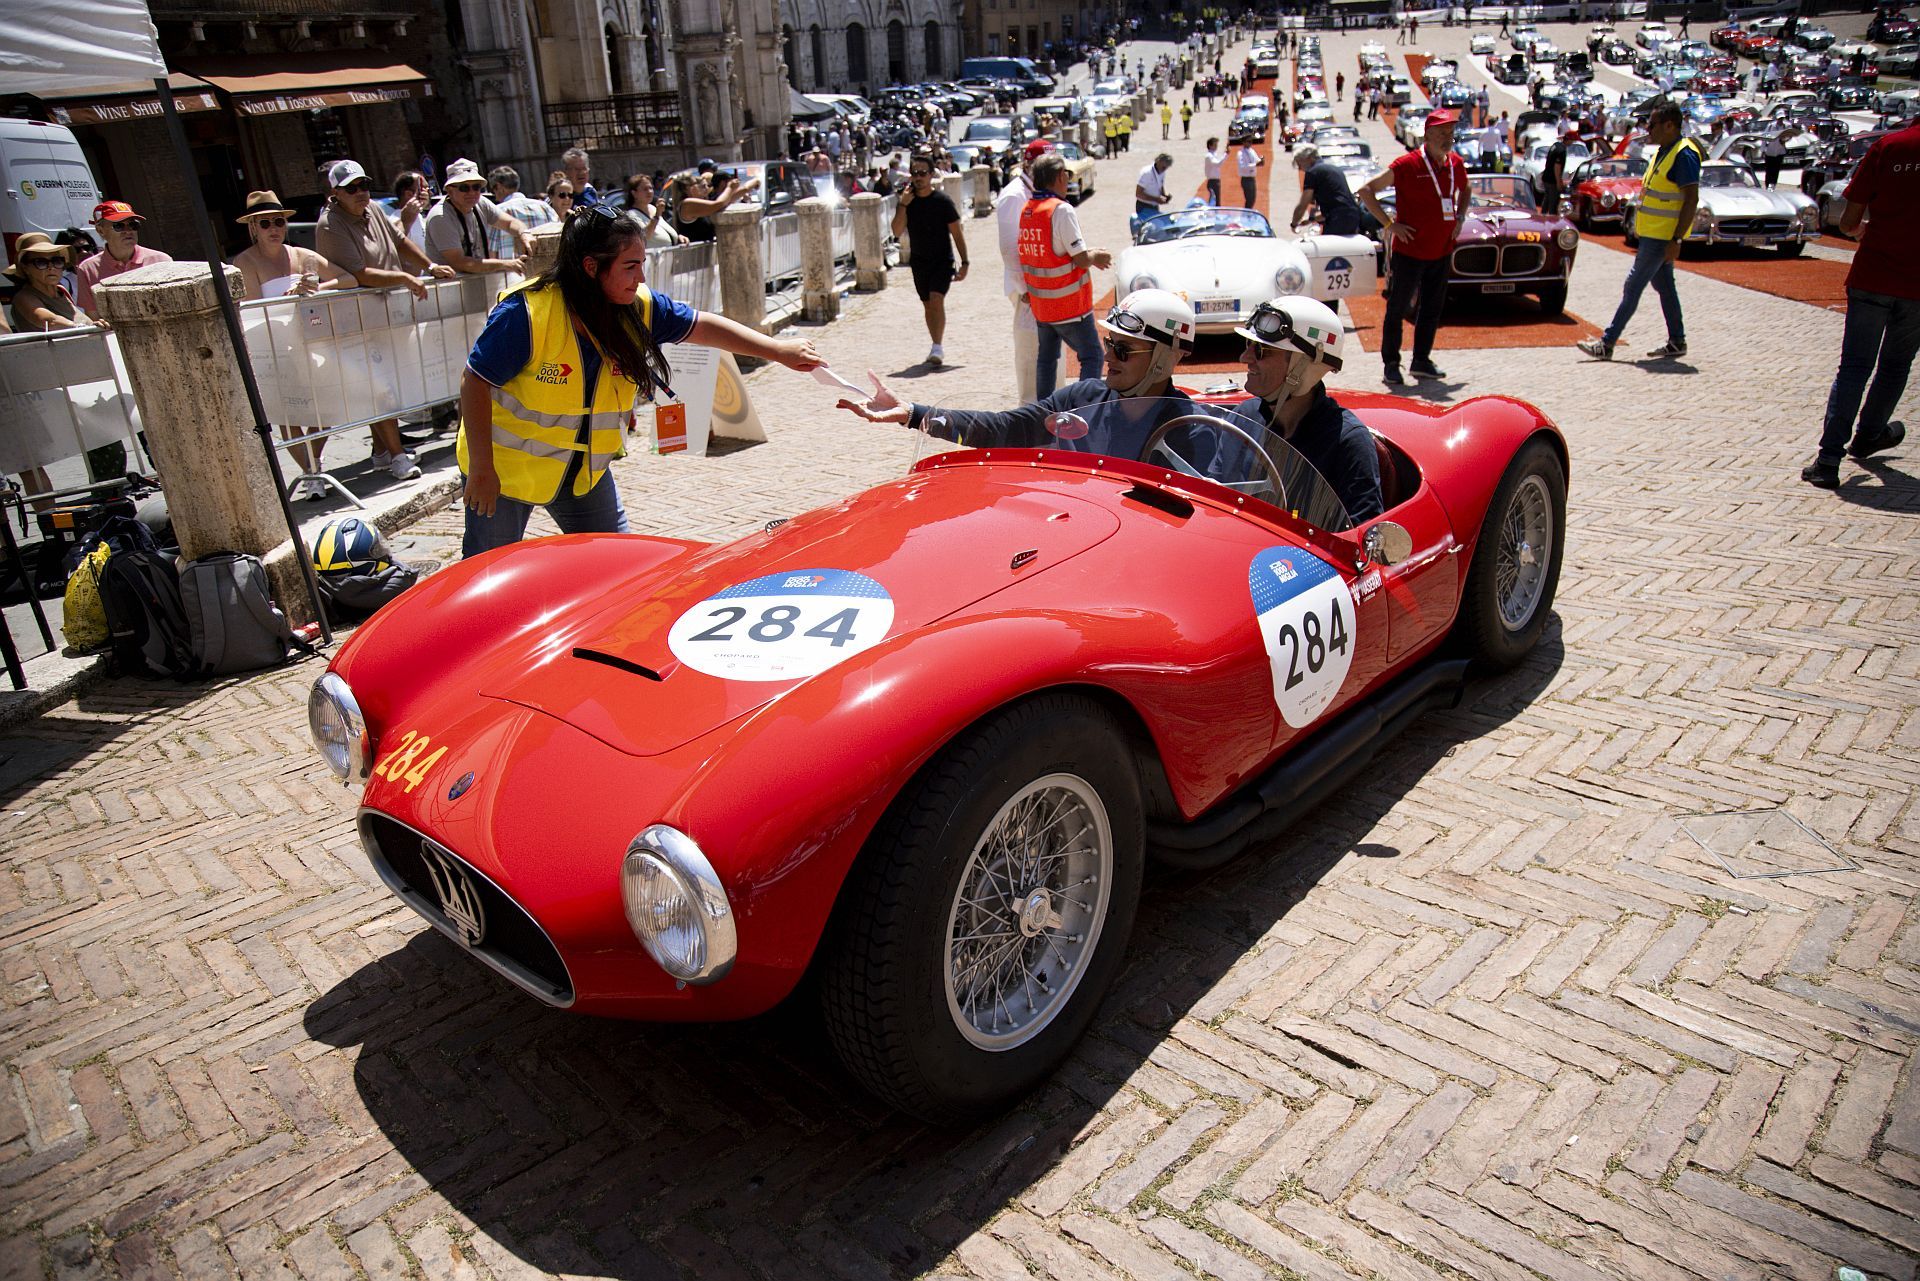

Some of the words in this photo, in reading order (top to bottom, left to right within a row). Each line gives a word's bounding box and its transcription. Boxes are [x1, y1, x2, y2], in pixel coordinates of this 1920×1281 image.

[92, 104, 131, 120] WINE
[240, 100, 266, 114] VINI
[264, 100, 278, 112] DI
[285, 96, 326, 110] TOSCANA
[1327, 273, 1351, 290] 293
[535, 374, 568, 385] MIGLIA
[687, 605, 860, 647] 284
[1279, 597, 1348, 692] 284
[375, 730, 448, 793] 284
